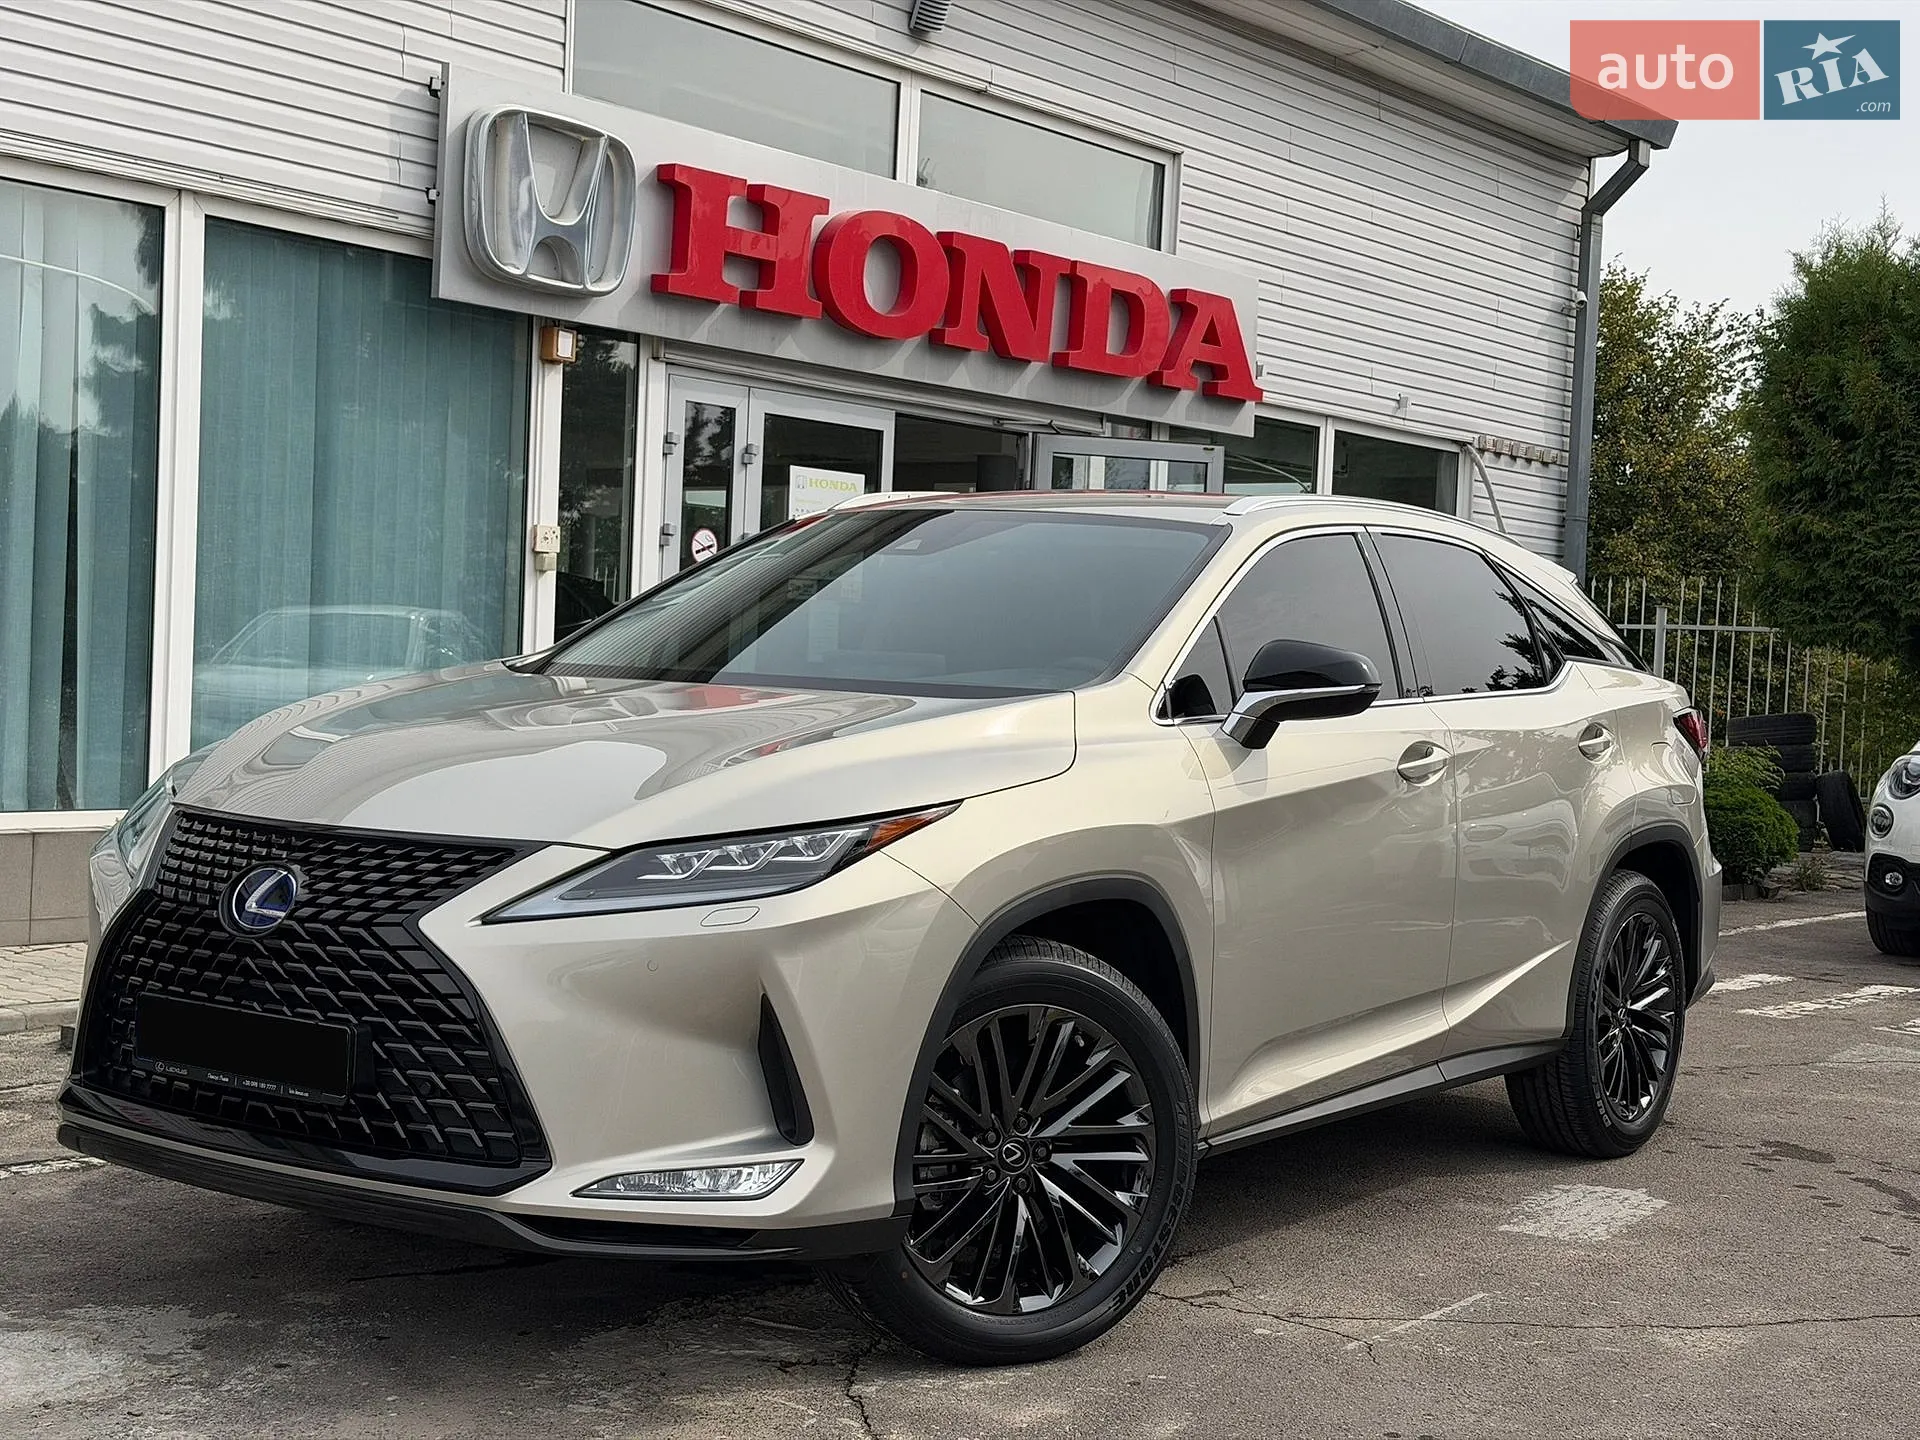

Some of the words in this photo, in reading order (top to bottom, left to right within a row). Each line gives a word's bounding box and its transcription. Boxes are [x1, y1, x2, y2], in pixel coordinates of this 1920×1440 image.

[651, 163, 1263, 401] HONDA
[808, 477, 858, 492] HONDA
[165, 1065, 188, 1076] LEXUS
